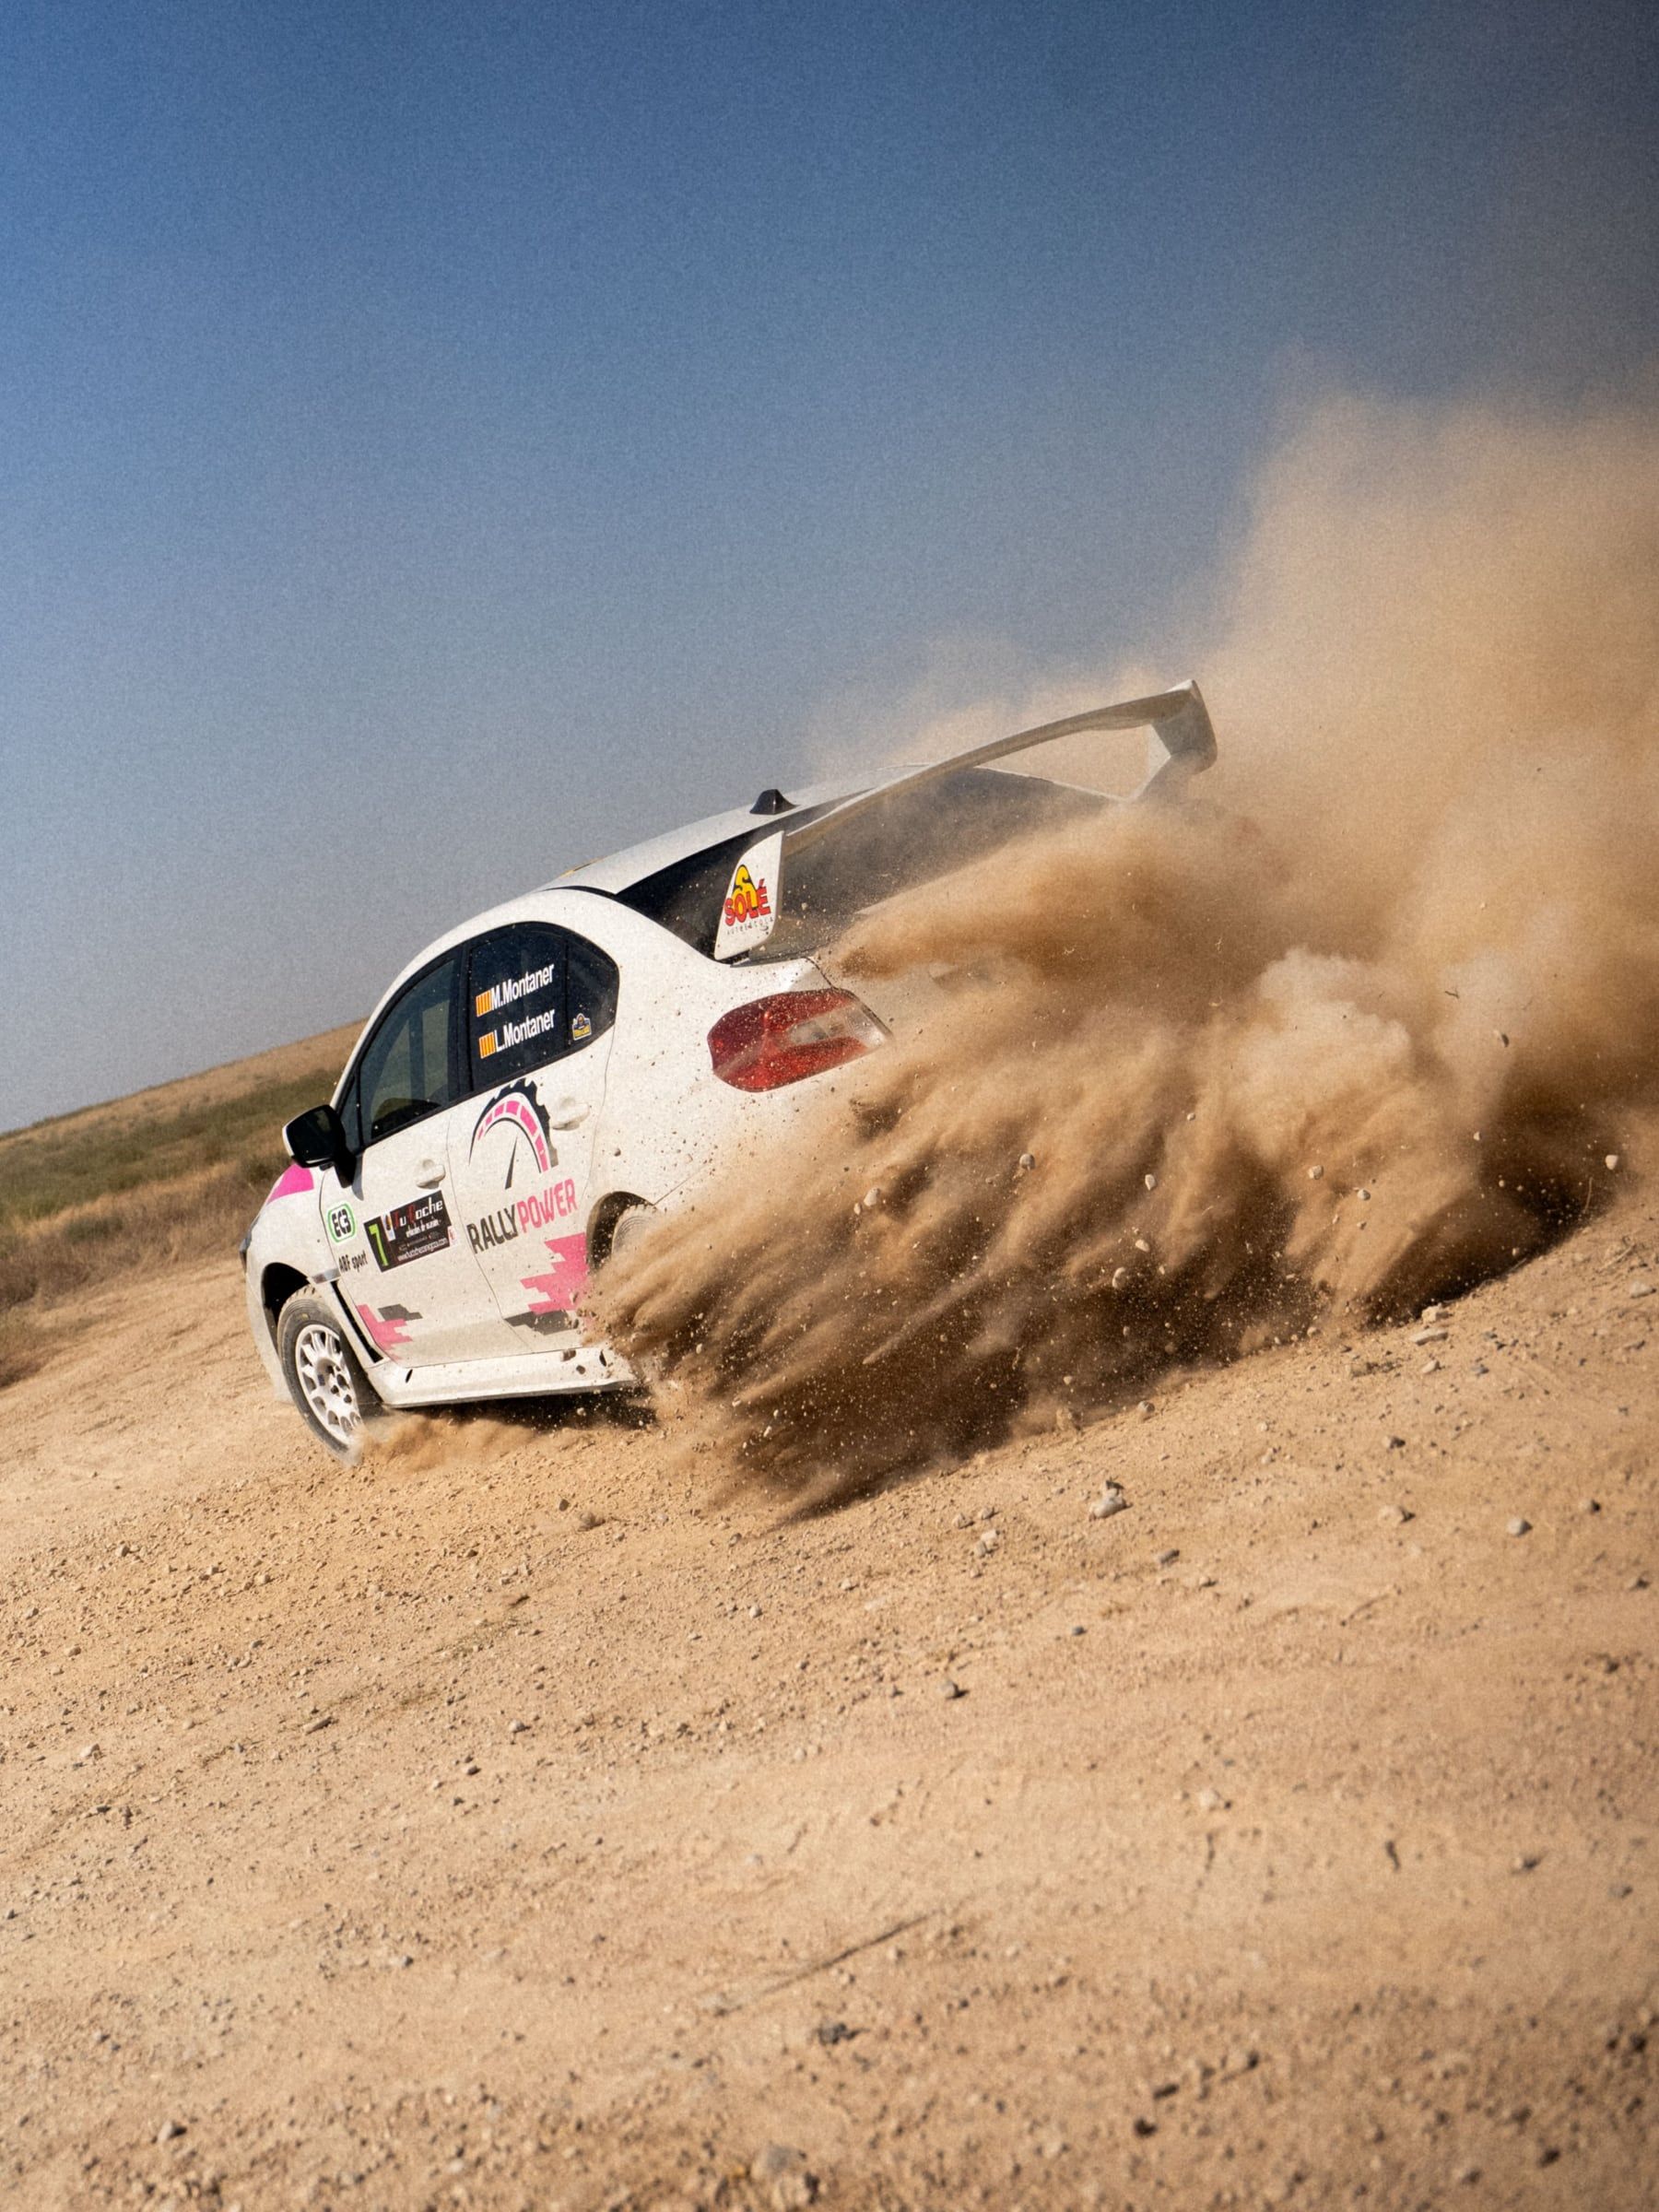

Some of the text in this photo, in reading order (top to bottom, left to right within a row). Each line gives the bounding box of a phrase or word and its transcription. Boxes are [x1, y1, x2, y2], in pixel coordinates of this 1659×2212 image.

[724, 878, 771, 926] SOLÉ
[490, 963, 555, 1011] M.Montaner
[493, 1009, 556, 1053] L.Montaner
[351, 1249, 369, 1273] sport
[369, 1223, 389, 1266] 7
